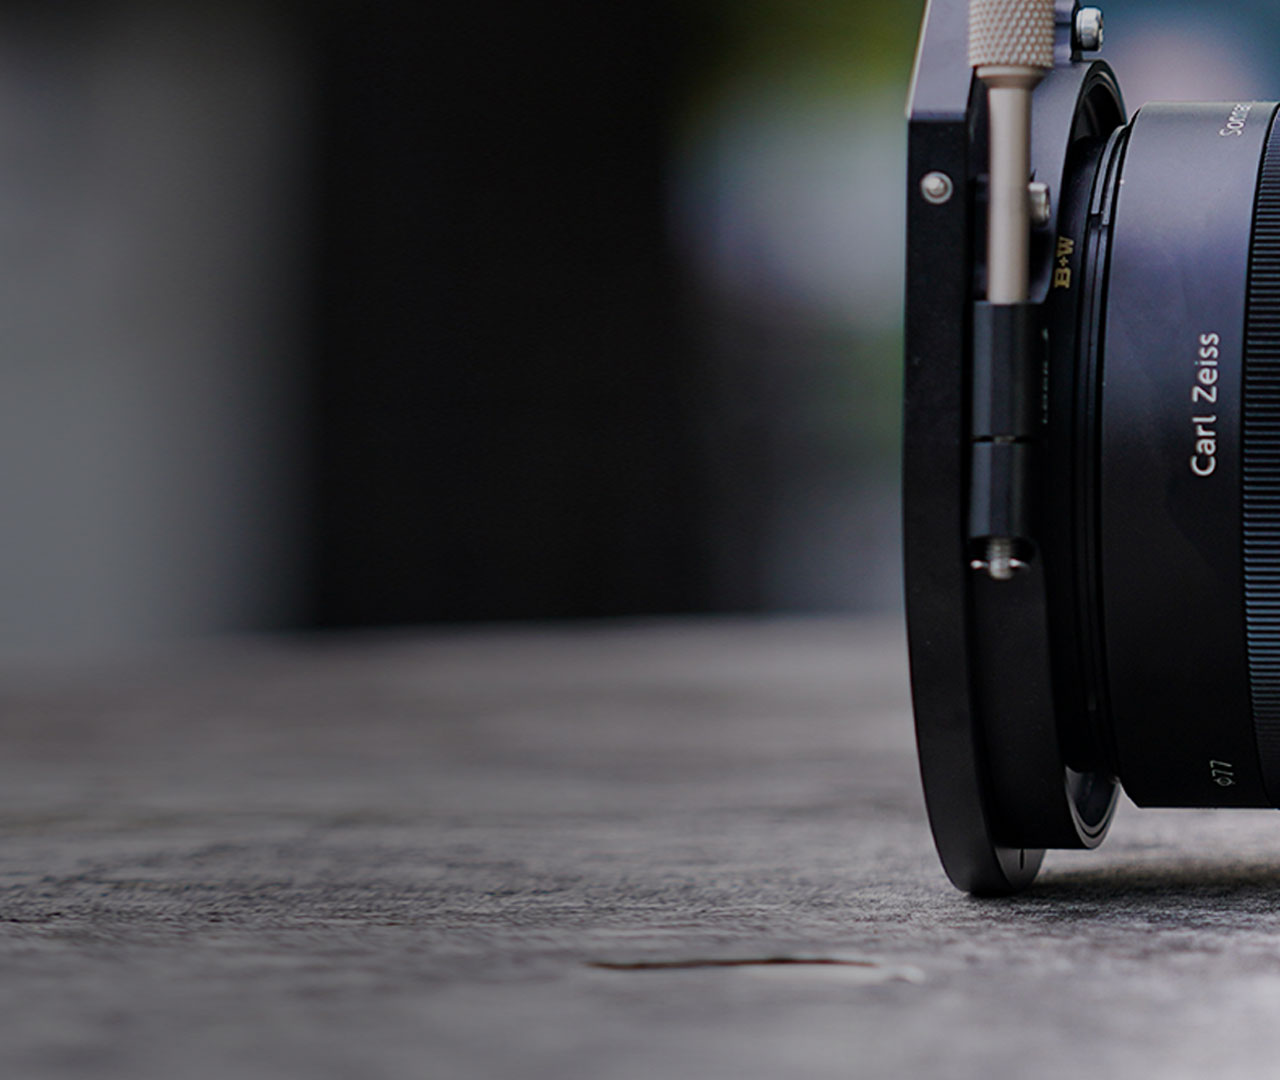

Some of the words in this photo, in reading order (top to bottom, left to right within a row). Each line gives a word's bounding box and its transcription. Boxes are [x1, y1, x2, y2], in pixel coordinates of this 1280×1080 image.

[1053, 236, 1074, 289] B+W
[1191, 332, 1219, 404] Zeiss
[1191, 414, 1217, 476] Carl
